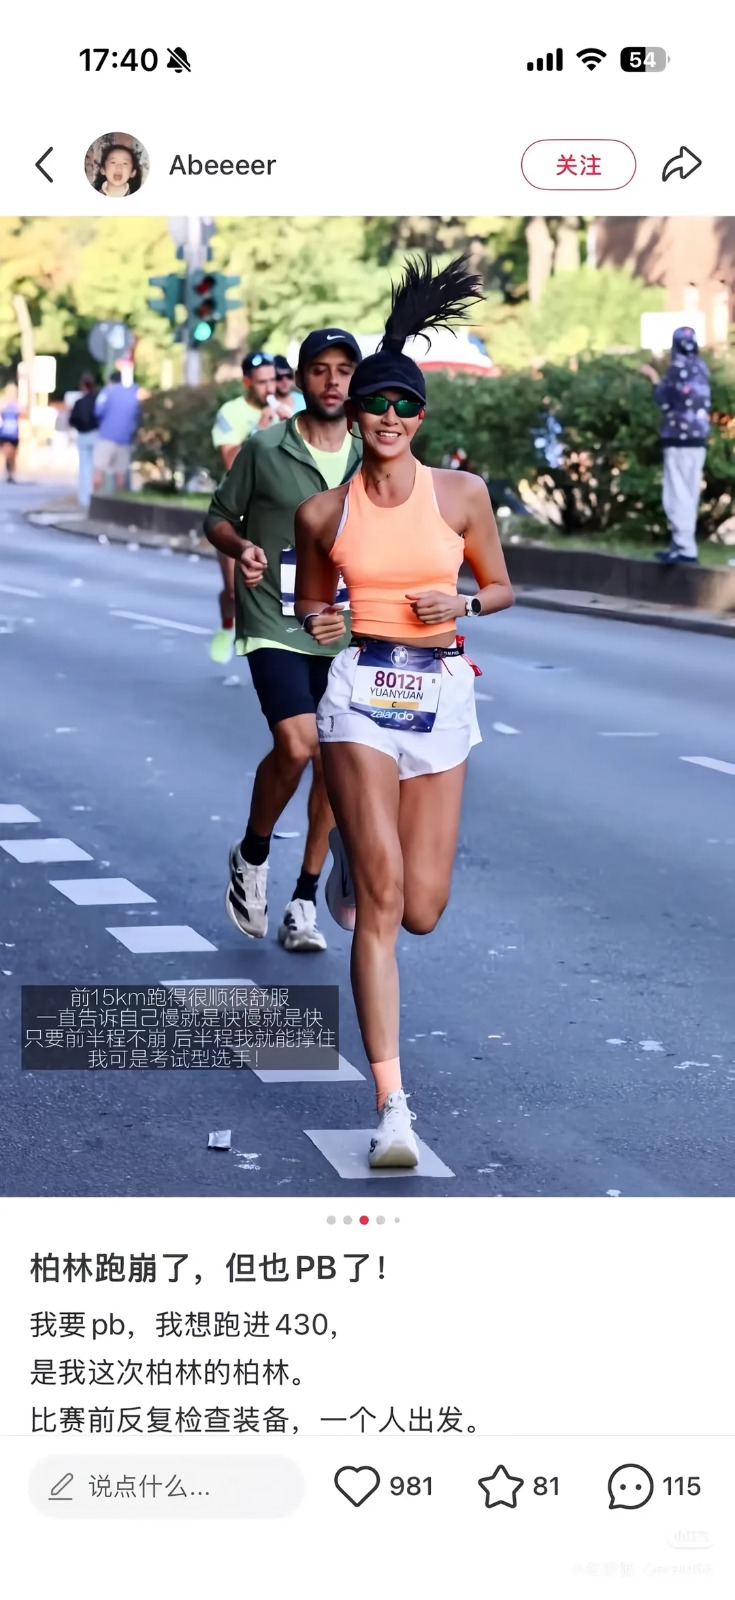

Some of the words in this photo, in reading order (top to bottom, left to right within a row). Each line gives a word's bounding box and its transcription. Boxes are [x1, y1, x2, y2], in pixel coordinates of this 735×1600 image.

[79, 47, 158, 73] 17:40
[629, 51, 657, 68] 54
[168, 153, 277, 177] Abeeeer
[556, 153, 602, 177] 关注
[374, 670, 423, 691] 80121
[370, 687, 424, 700] YUANYUAN
[371, 710, 414, 721] zalando
[30, 1358, 301, 1386] 是我这次柏林的柏林。
[31, 1405, 476, 1435] 比赛前反复检查装备，一个人出发。
[389, 1475, 433, 1497] 981
[533, 1475, 559, 1497] 81
[662, 1476, 701, 1497] 115
